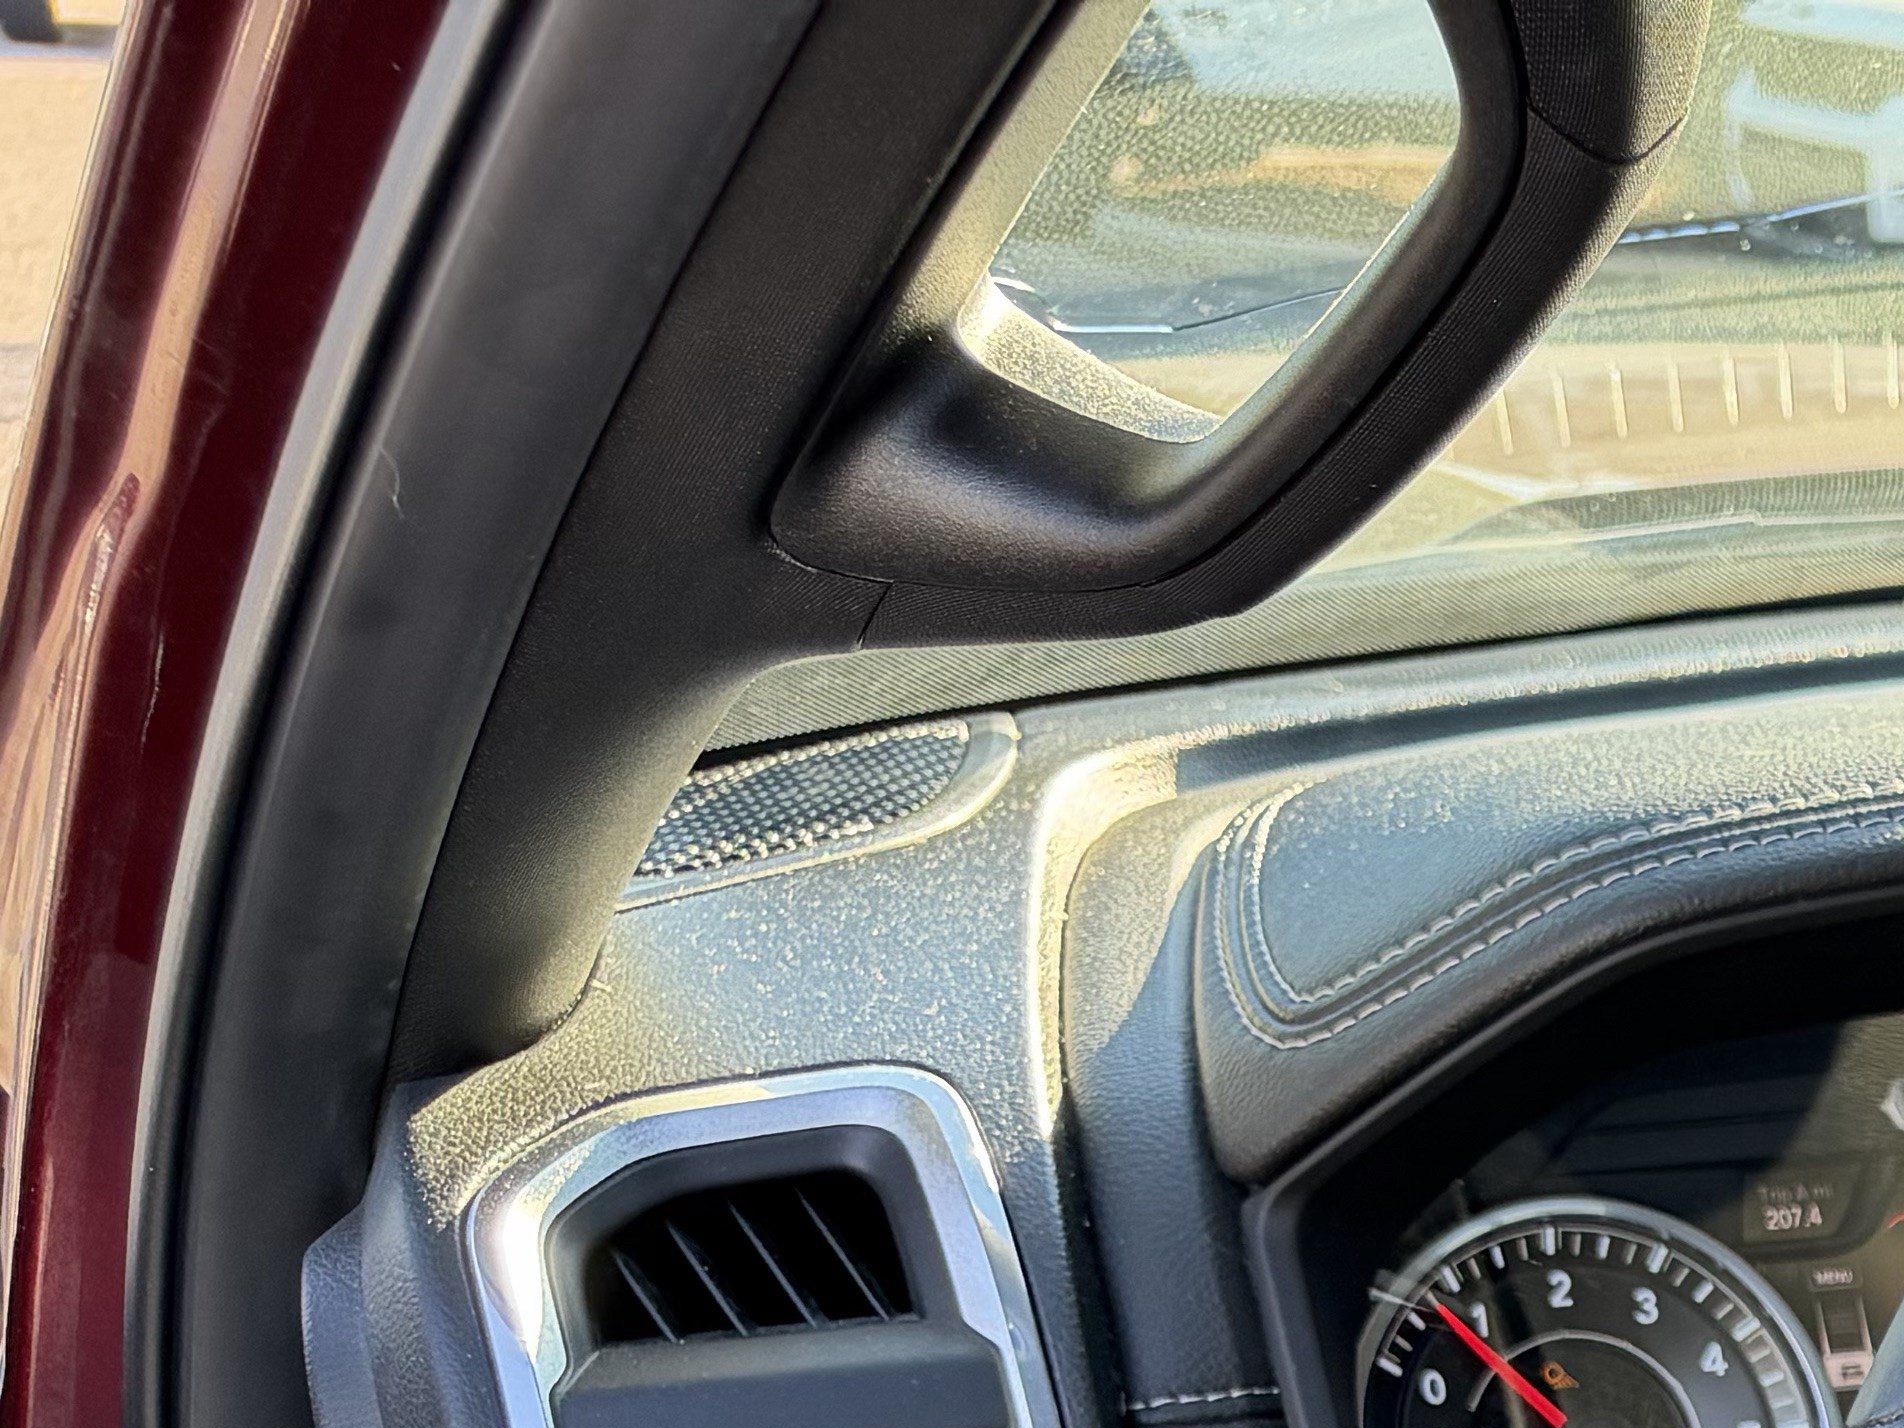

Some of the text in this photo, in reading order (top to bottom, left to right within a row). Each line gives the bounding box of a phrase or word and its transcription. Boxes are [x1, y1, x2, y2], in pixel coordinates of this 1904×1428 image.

[1547, 1269, 1574, 1309] 2
[1631, 1286, 1660, 1325] 3
[1469, 1302, 1489, 1338] 1
[1700, 1340, 1729, 1377] 4
[1418, 1367, 1447, 1406] 0
